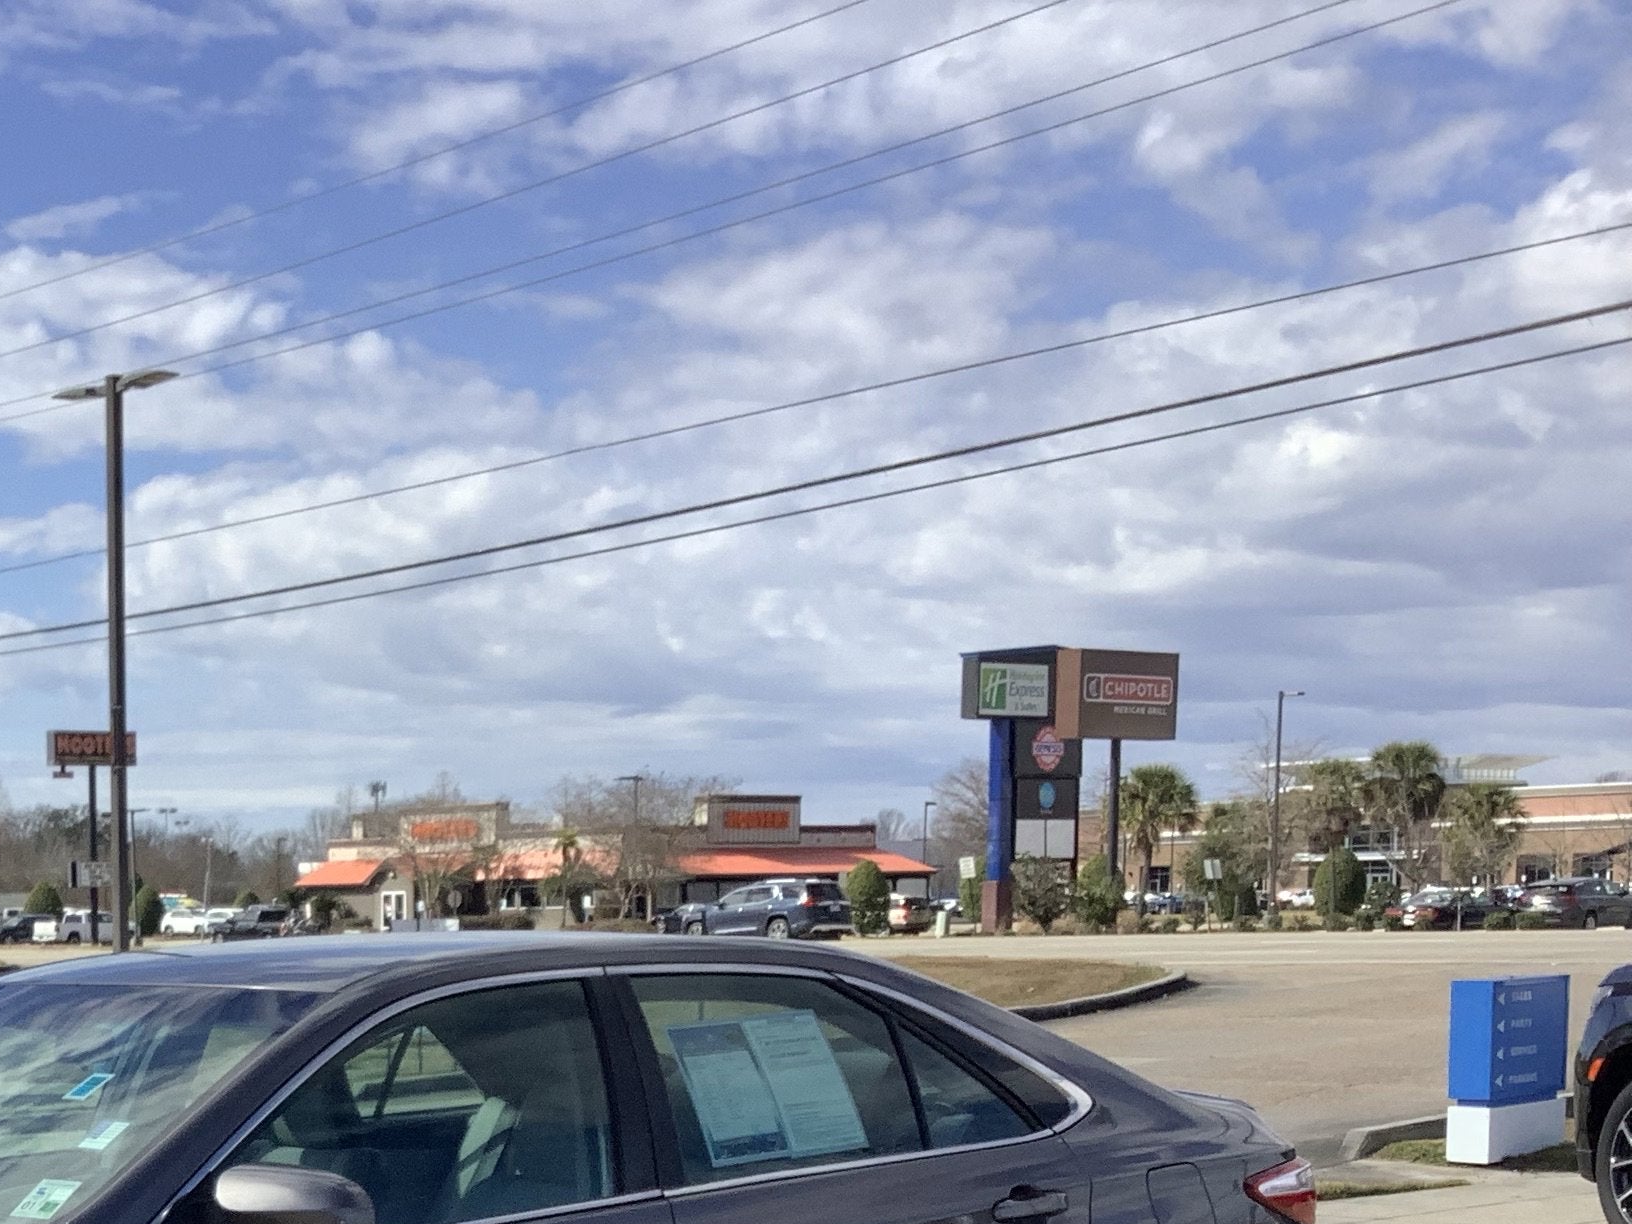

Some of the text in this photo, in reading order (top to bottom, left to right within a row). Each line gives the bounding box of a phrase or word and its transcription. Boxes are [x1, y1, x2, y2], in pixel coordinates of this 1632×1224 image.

[1009, 682, 1045, 700] Express
[1105, 681, 1169, 698] CHIPOTLE
[1113, 706, 1168, 716] MEXICAN GRILL
